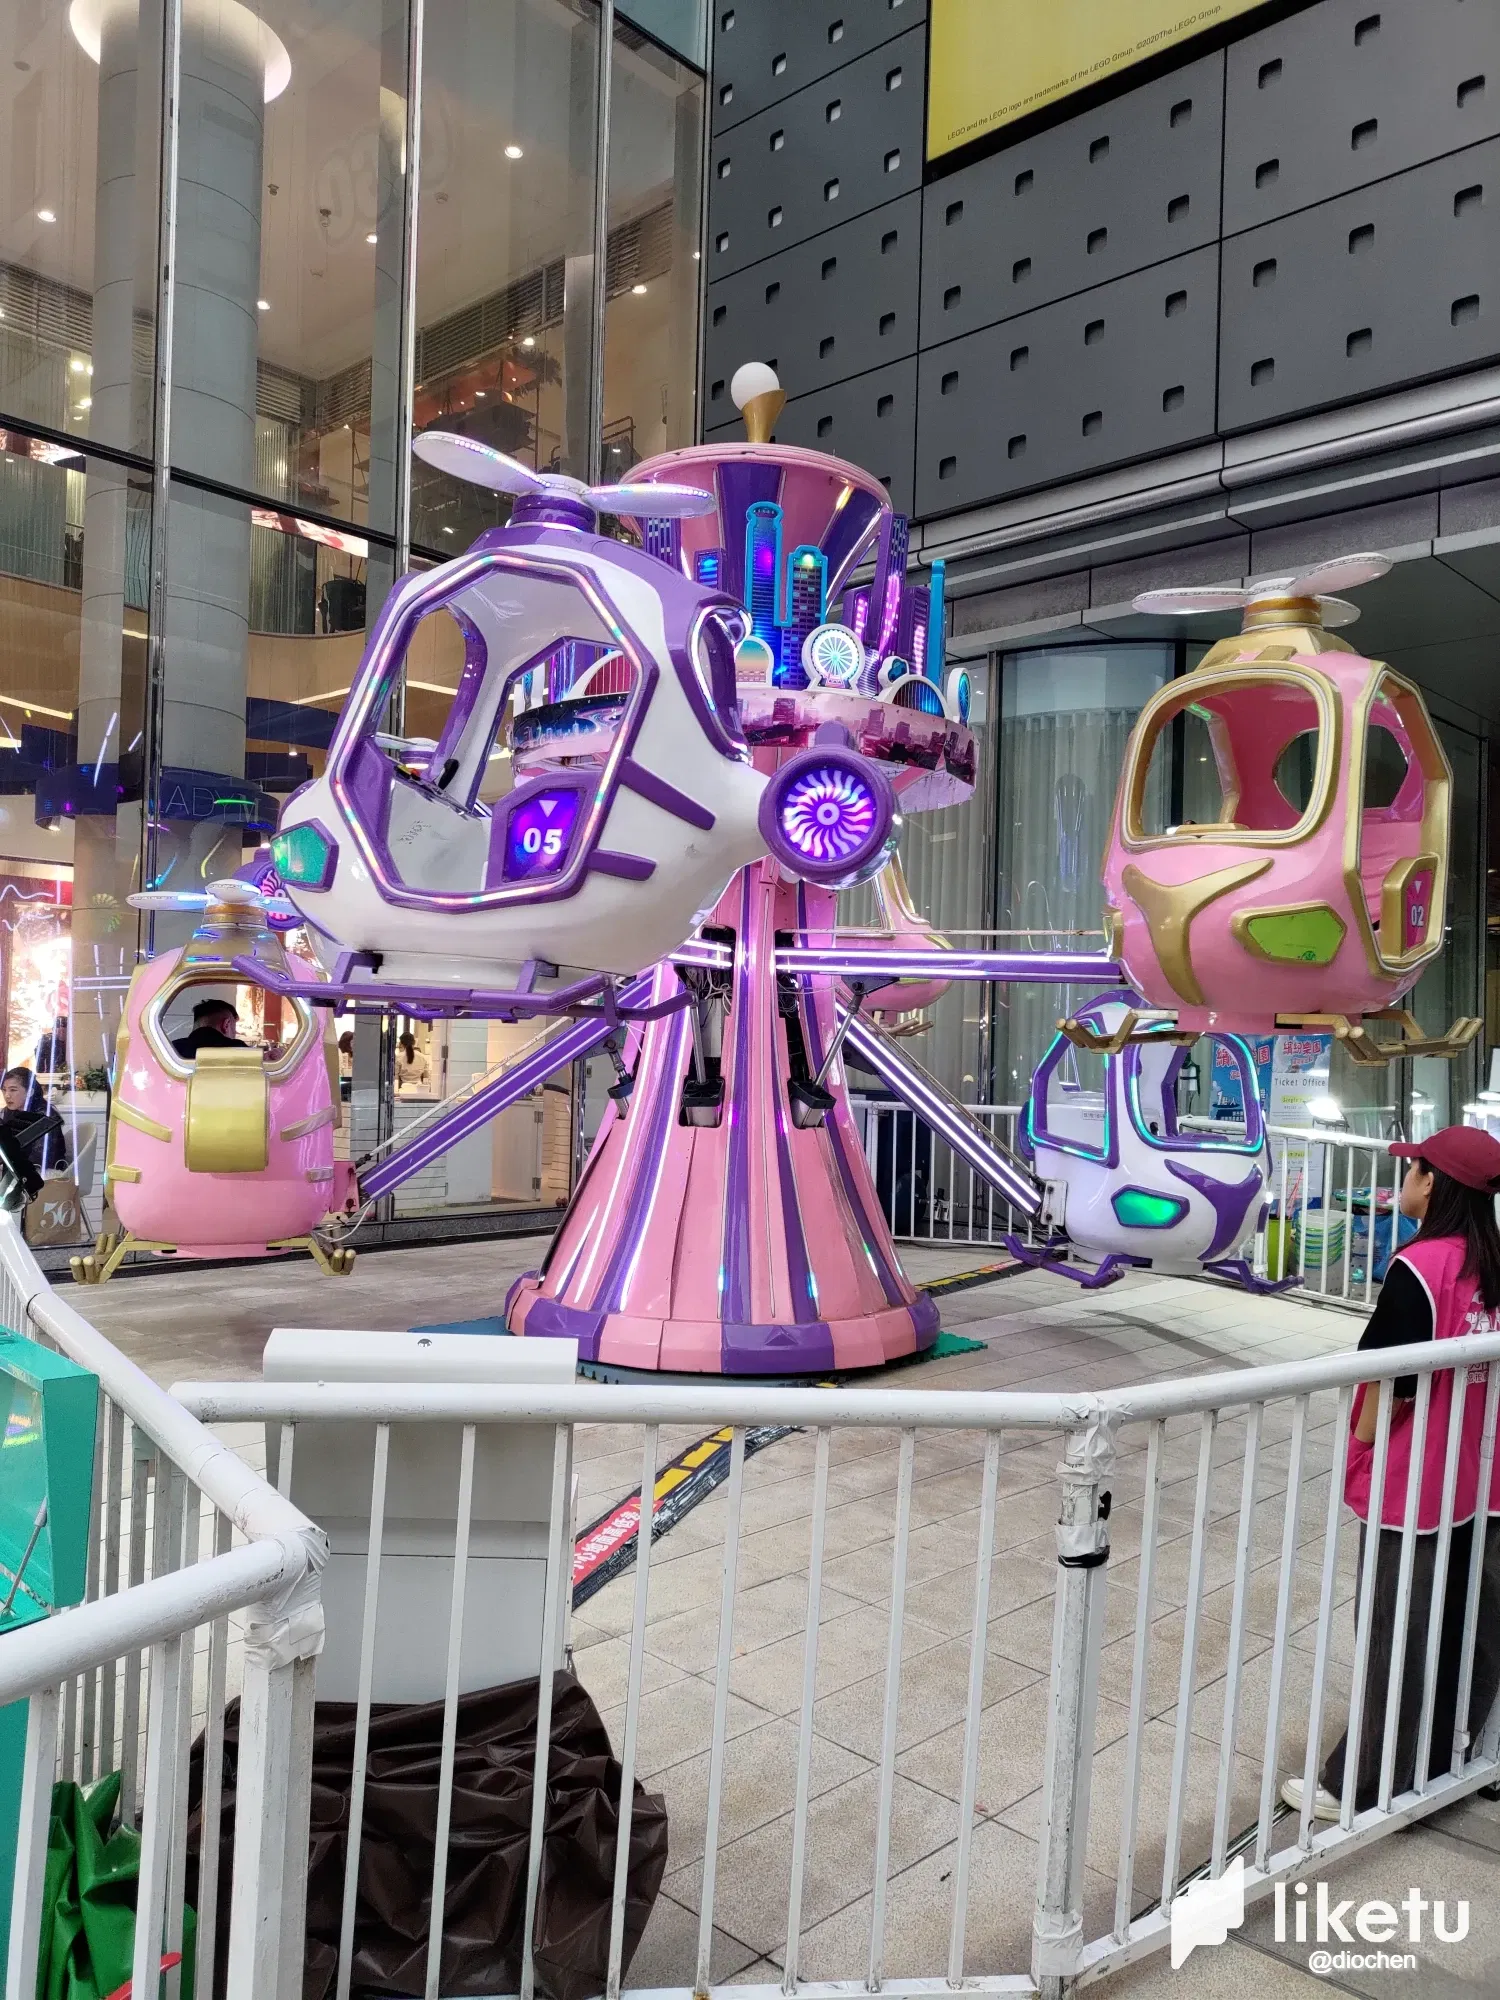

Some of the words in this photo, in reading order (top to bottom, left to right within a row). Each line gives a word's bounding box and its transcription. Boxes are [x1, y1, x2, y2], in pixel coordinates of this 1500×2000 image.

[947, 127, 966, 141] LEGO
[966, 122, 978, 132] and
[978, 117, 988, 126] the
[989, 107, 1008, 121] LEGO
[1009, 101, 1022, 113] logo
[1023, 96, 1034, 105] are
[1034, 78, 1069, 100] trademarks
[1070, 72, 1078, 82] of
[1078, 69, 1089, 78] the
[1090, 57, 1111, 73] LEGO
[1174, 16, 1196, 32] LEGO
[523, 828, 562, 855] 05
[1411, 905, 1424, 926] 02
[1275, 1078, 1298, 1086] Ticket
[1302, 1077, 1326, 1086] Office
